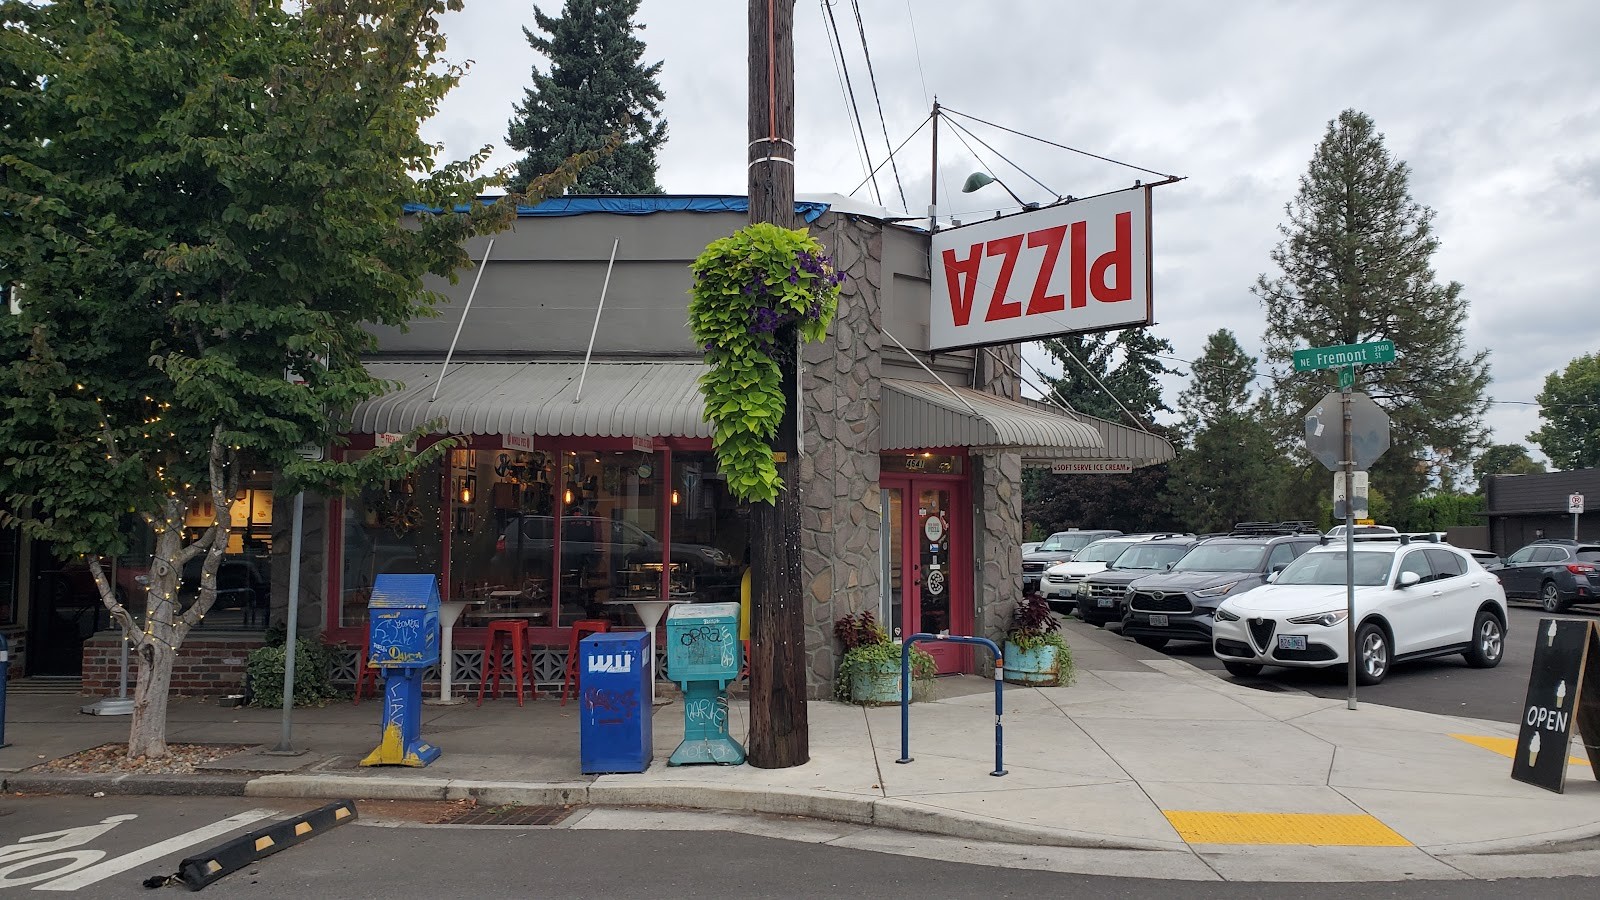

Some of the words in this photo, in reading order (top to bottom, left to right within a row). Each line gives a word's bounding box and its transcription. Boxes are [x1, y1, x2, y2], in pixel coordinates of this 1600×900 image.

[942, 211, 1132, 327] PIZZA
[1300, 358, 1311, 367] NE
[1317, 348, 1367, 366] Fremont
[1373, 344, 1389, 353] 3500
[906, 459, 924, 468] 4641
[1527, 706, 1568, 733] OPEN
